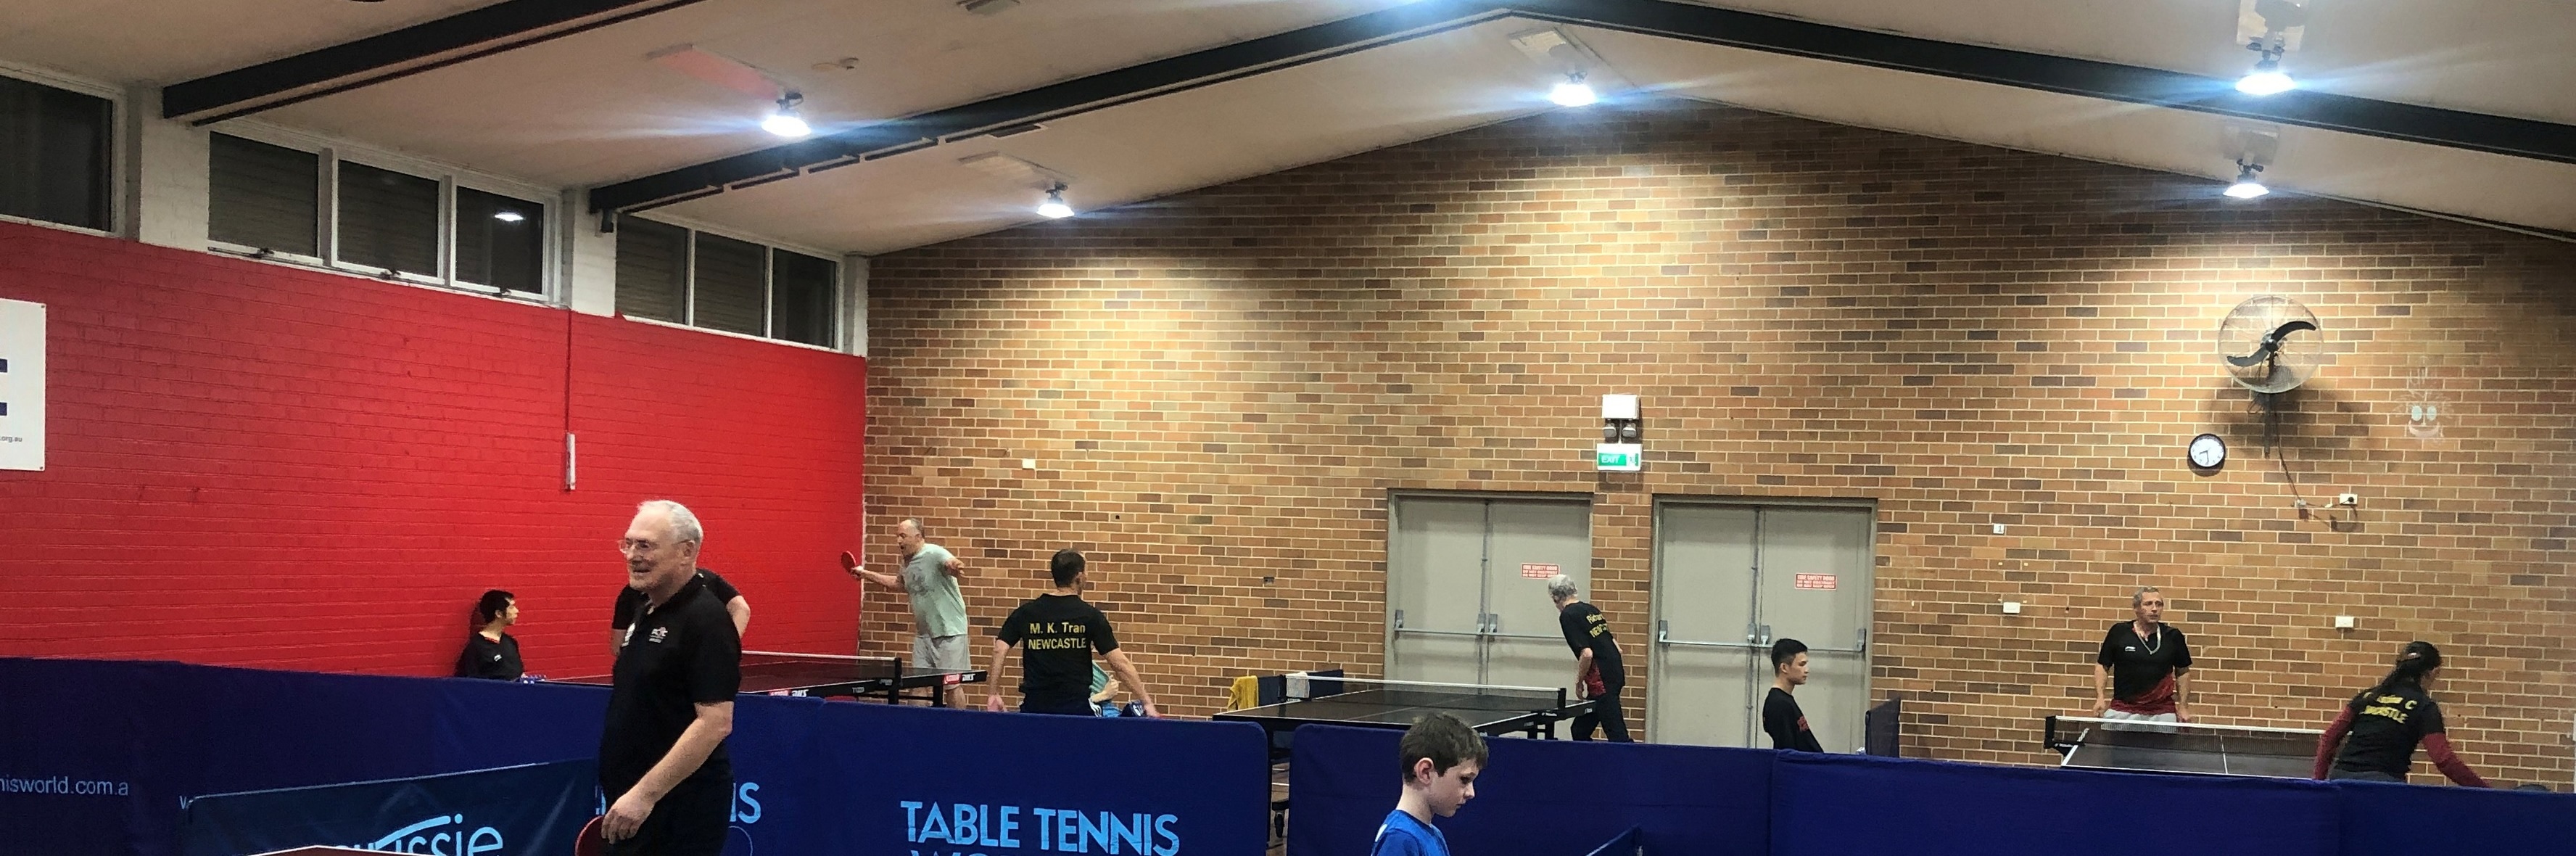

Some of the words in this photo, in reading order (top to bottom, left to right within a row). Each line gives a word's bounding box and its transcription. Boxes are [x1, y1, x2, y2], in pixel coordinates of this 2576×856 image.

[1601, 454, 1620, 464] EXIT
[1030, 622, 1044, 635] M.
[1046, 622, 1058, 634] K.
[1061, 622, 1086, 633] Tran
[1028, 638, 1087, 650] NEWCASTLE
[900, 800, 1020, 848] TABLE
[1033, 807, 1180, 856] TENNIS
